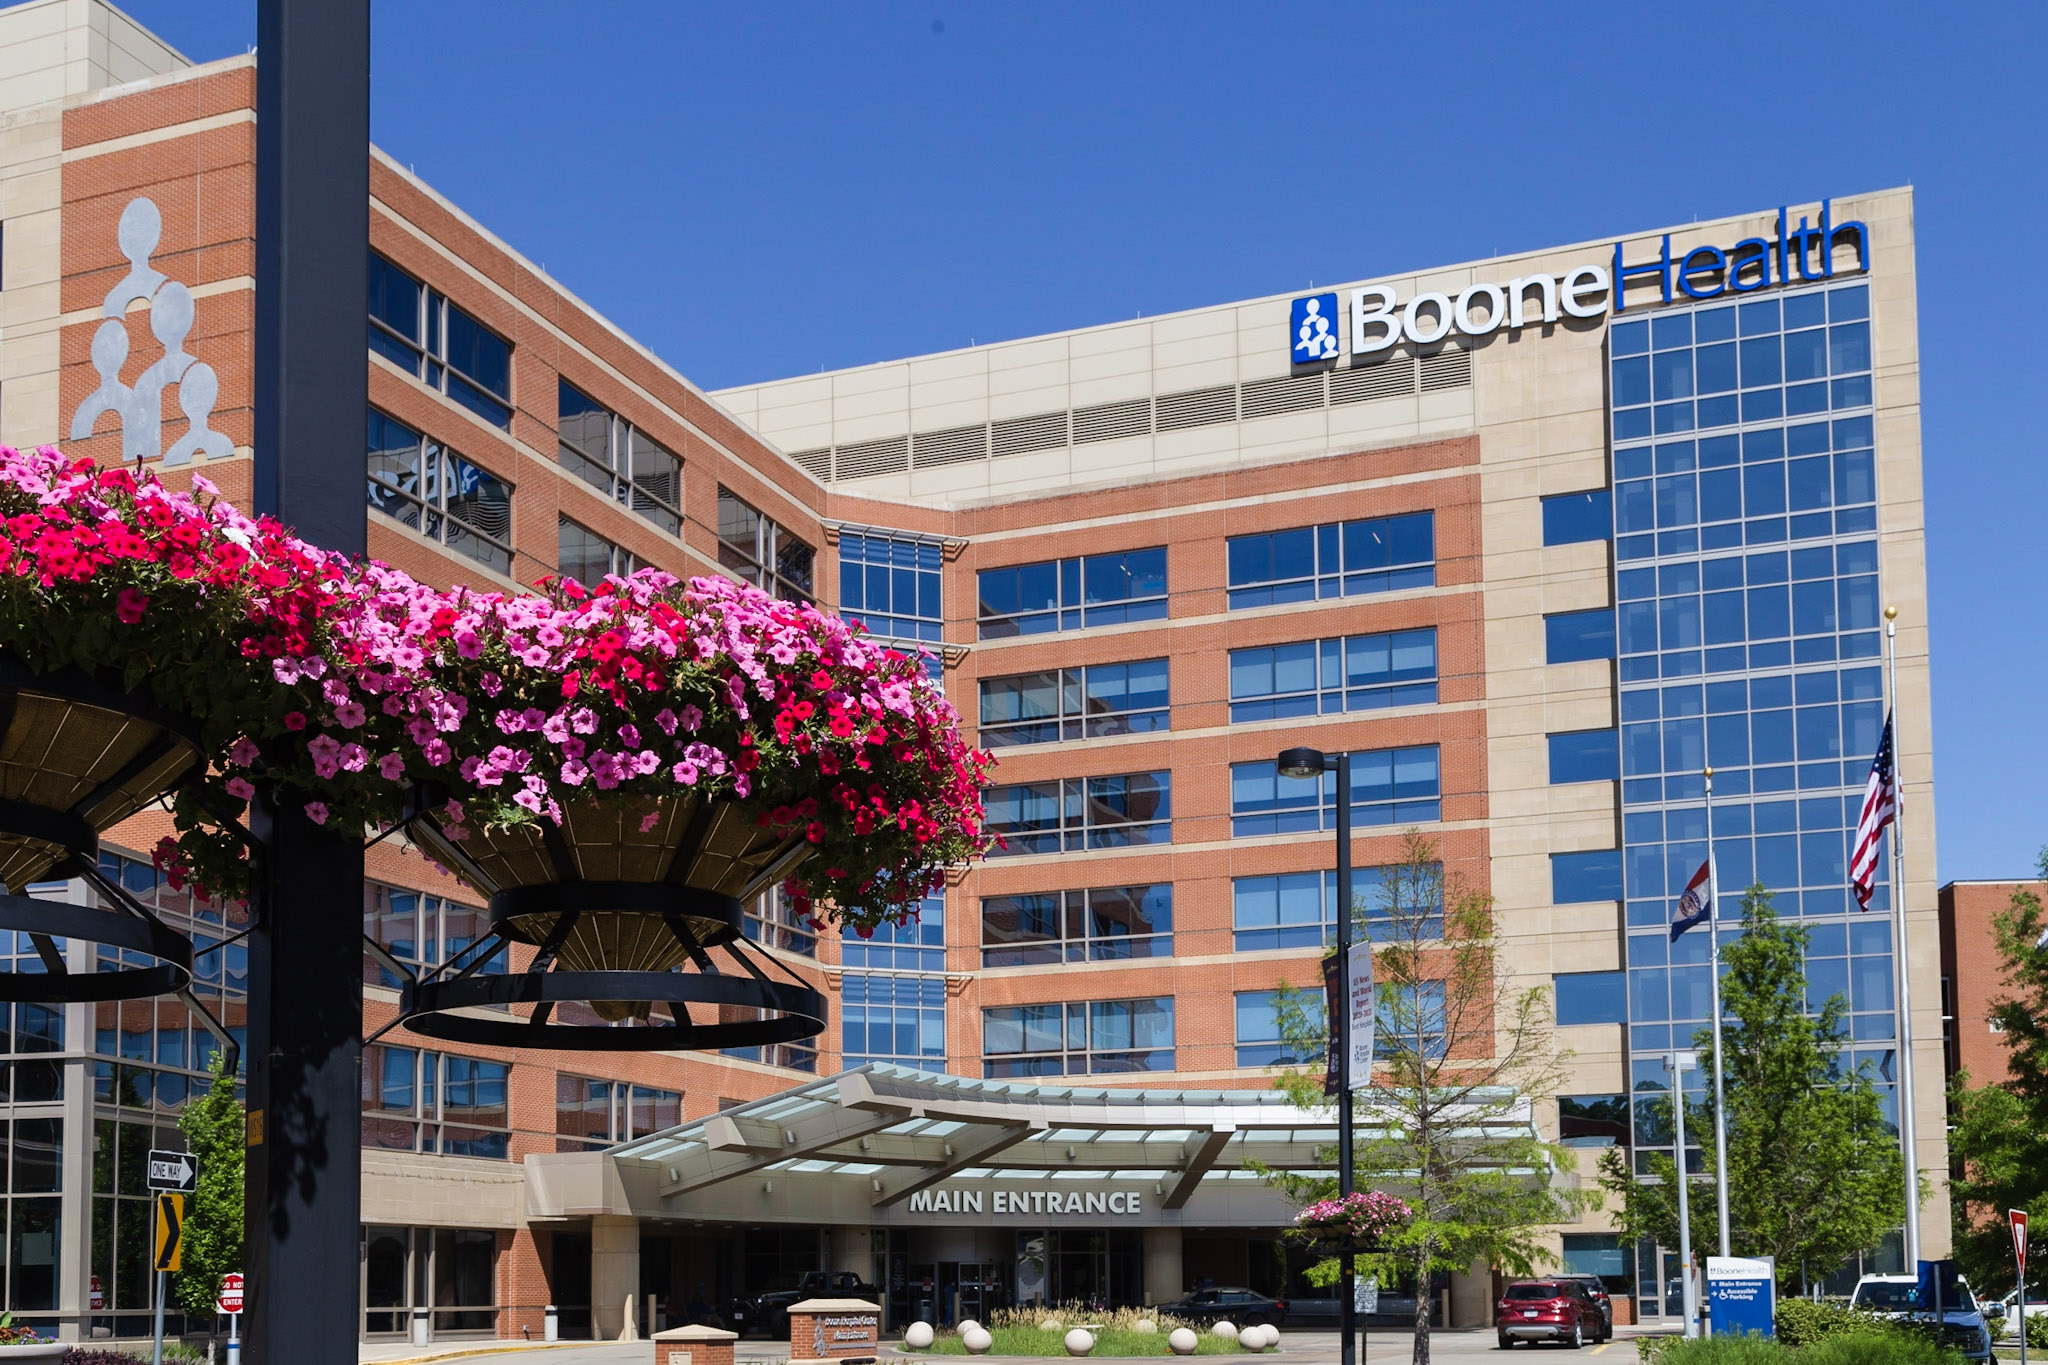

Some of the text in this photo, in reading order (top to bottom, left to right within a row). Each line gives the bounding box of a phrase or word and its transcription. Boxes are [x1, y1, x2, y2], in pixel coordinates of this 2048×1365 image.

[153, 1162, 182, 1178] ONE WAY
[909, 1189, 1141, 1214] MAIN ENTRANCE
[223, 1298, 243, 1306] ENTER
